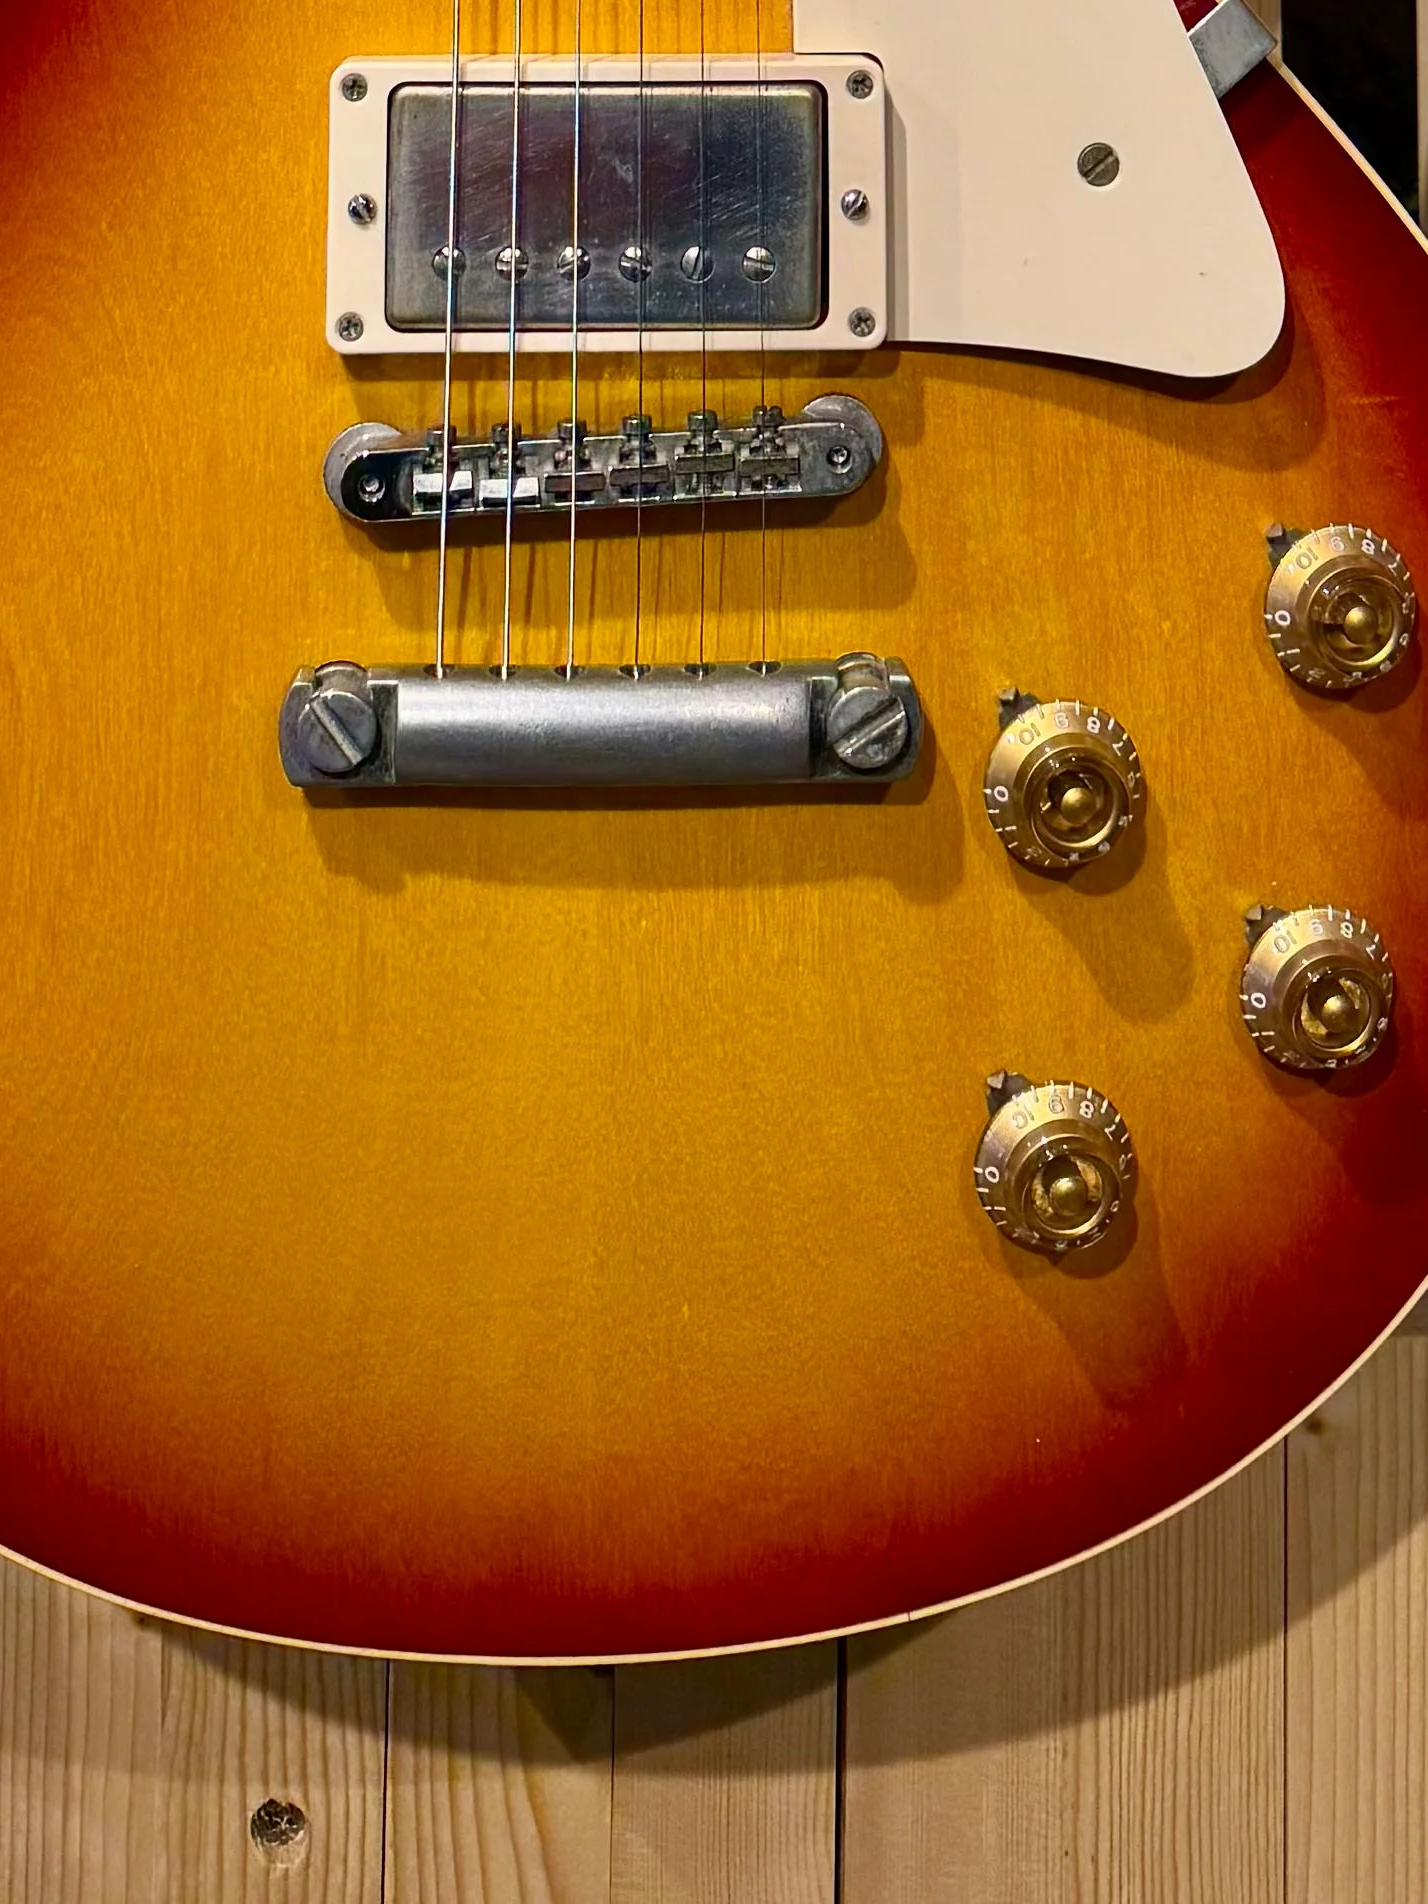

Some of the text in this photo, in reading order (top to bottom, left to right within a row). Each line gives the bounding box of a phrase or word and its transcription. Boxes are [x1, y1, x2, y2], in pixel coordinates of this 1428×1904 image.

[1274, 609, 1291, 626] 0
[1361, 539, 1375, 554] 8
[994, 785, 1009, 802] 0
[1086, 716, 1100, 734] 8
[1250, 992, 1267, 1009] 0
[1340, 921, 1353, 939] 8
[984, 1166, 999, 1184] 0
[1079, 1100, 1094, 1119] 8
